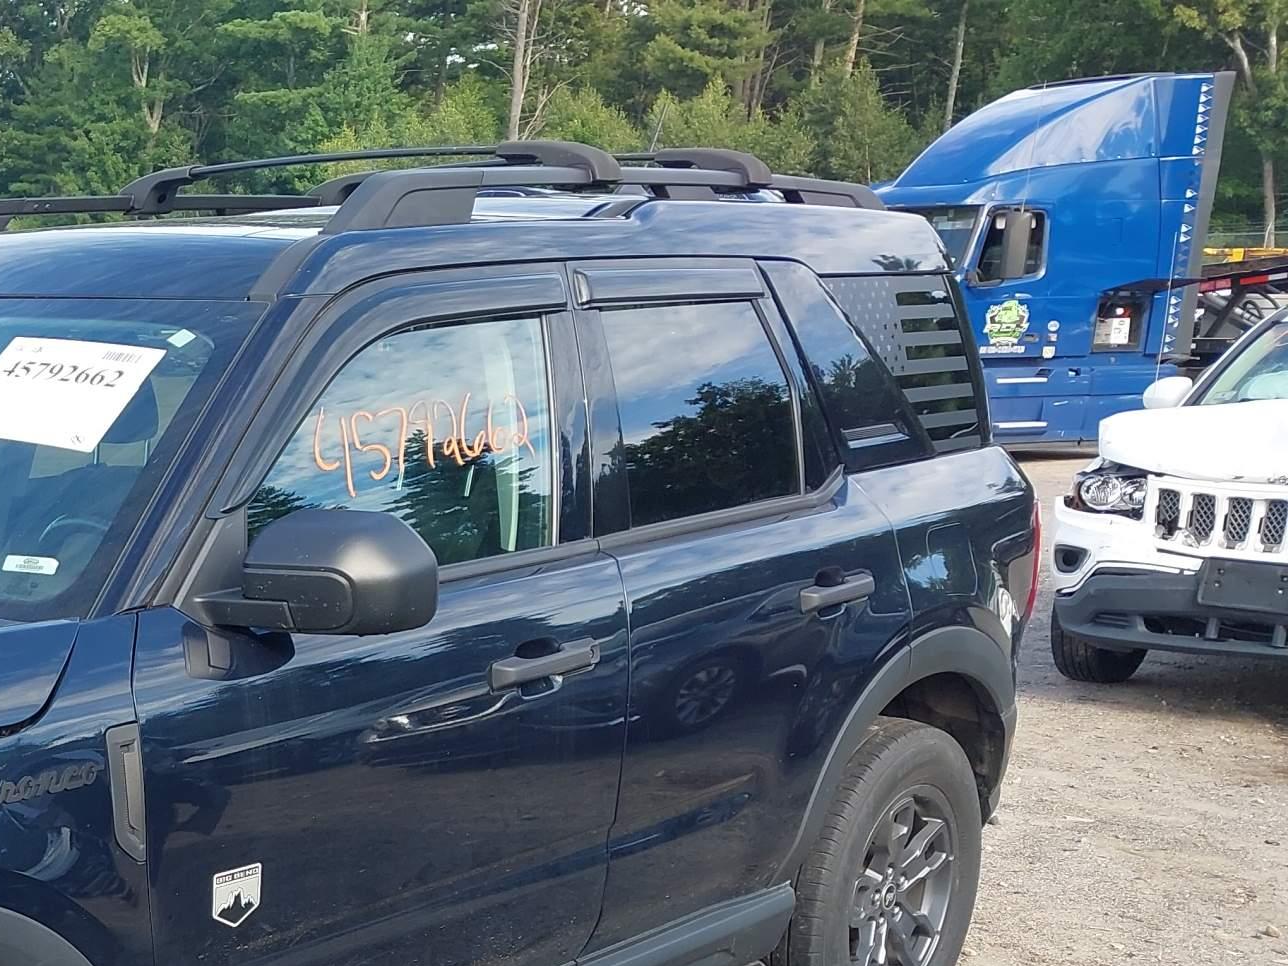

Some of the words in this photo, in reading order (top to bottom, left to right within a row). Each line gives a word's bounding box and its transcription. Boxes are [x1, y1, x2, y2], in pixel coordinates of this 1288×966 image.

[2, 360, 125, 389] 45792662
[313, 392, 536, 498] 45792662
[234, 868, 259, 879] BEND
